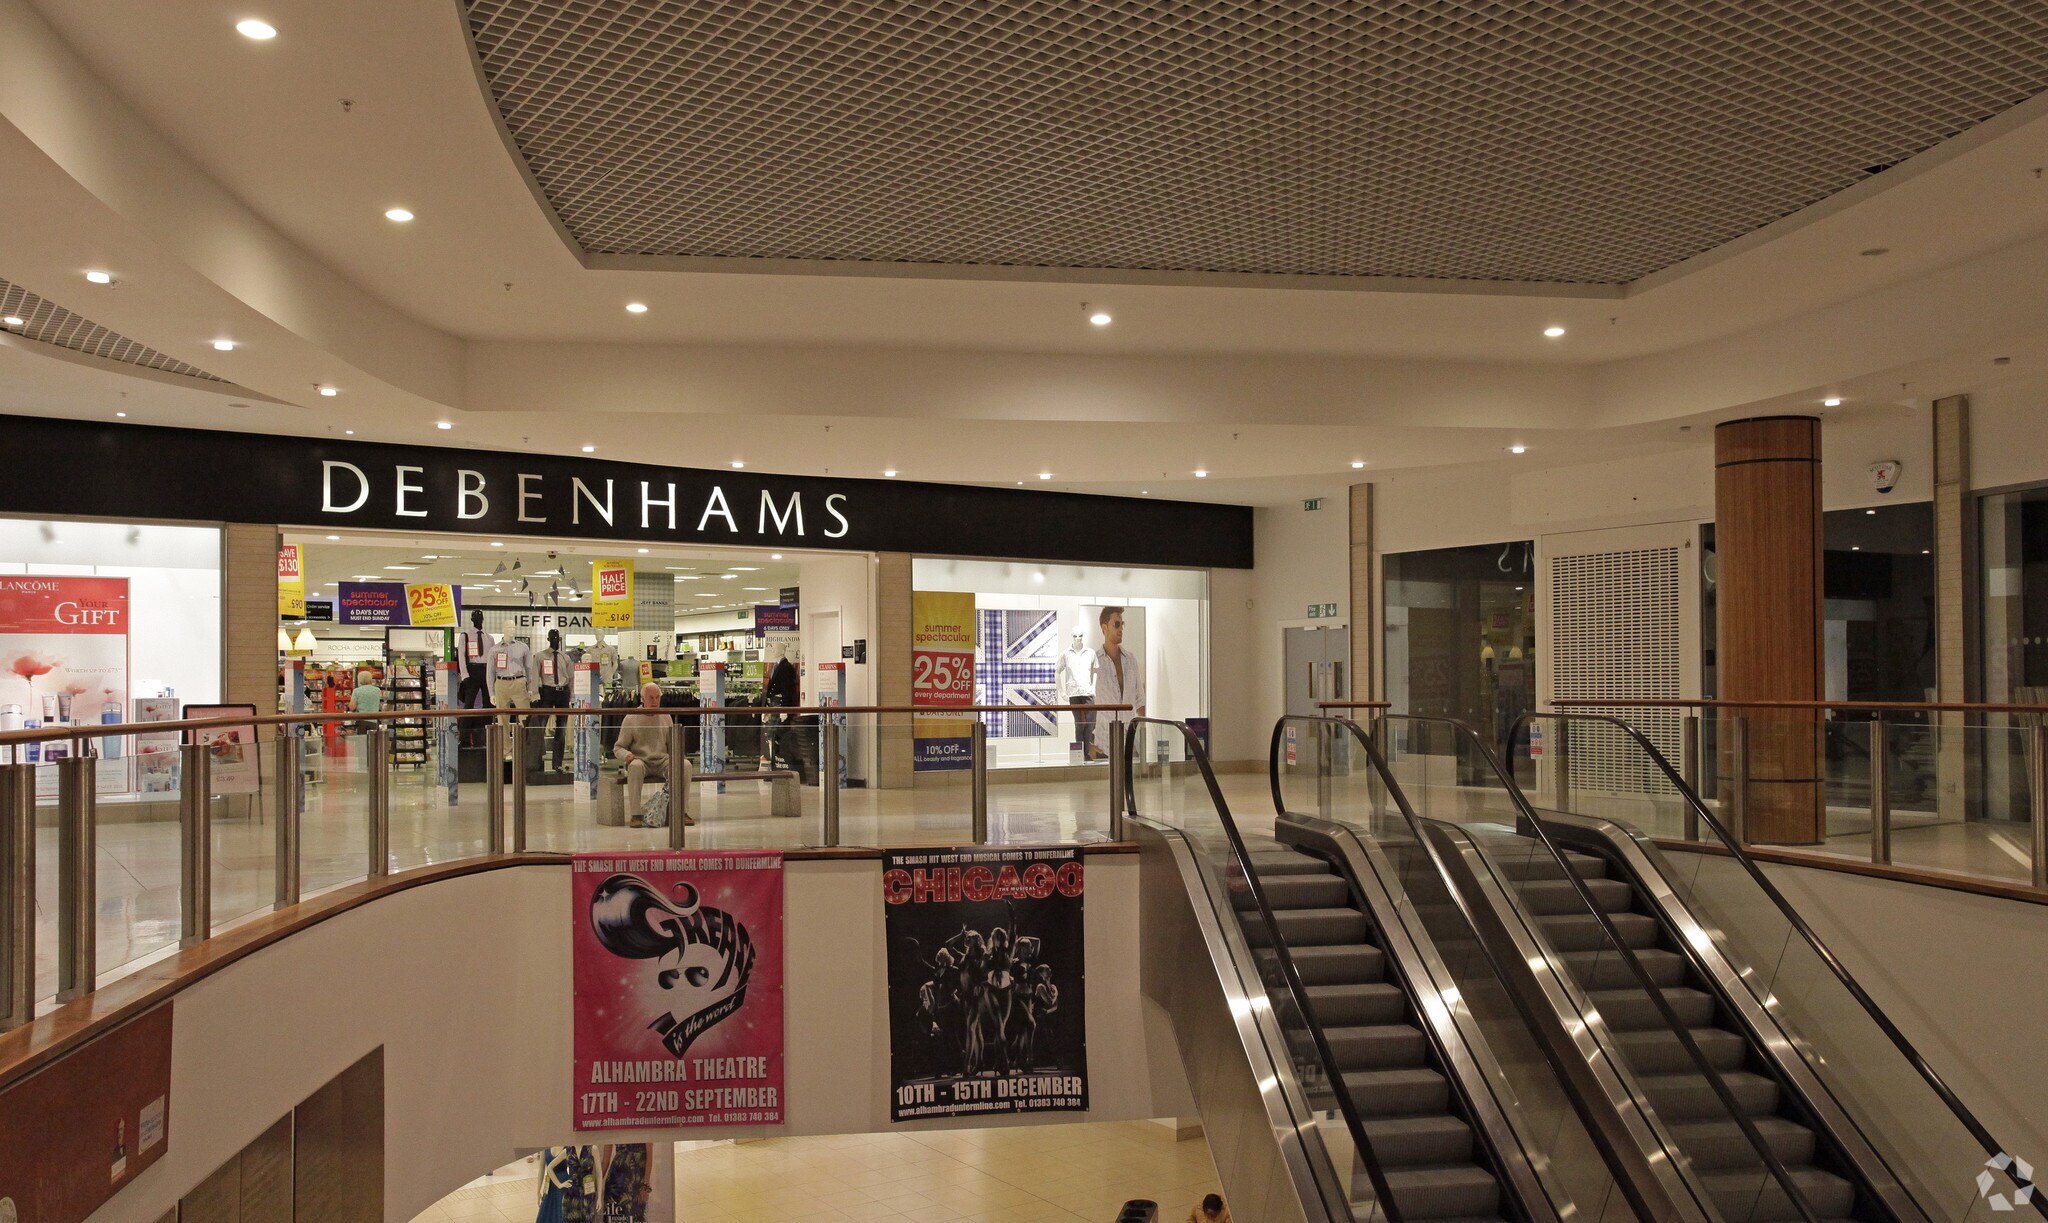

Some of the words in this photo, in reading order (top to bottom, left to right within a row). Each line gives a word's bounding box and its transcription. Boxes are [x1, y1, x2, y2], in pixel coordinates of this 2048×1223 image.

[322, 460, 848, 538] DEBENHAMS
[280, 548, 296, 557] SAVE
[279, 559, 298, 572] £130
[0, 581, 59, 591] LANCÔME
[601, 573, 625, 584] HALF
[601, 583, 625, 593] PRICE
[291, 599, 303, 609] £90
[341, 598, 399, 607] spectacular
[409, 586, 448, 609] 25%
[54, 601, 119, 625] GIFT
[610, 613, 630, 622] £149
[924, 624, 961, 632] summer
[915, 633, 970, 643] spectacular
[913, 655, 971, 690] 25%
[951, 680, 971, 691] OFF
[933, 692, 970, 700] department
[926, 745, 942, 755] 10%
[943, 745, 960, 755] OFF
[573, 860, 587, 873] THE
[588, 859, 614, 872] SMASH
[615, 859, 627, 872] HIT
[629, 859, 649, 872] WEST
[651, 858, 664, 871] END
[666, 858, 697, 871] MUSICAL
[699, 857, 723, 870] COMES
[724, 857, 734, 870] TO
[735, 856, 782, 870] DUNFERMLINE
[892, 856, 904, 865] THE
[905, 856, 927, 864] SMASH
[928, 855, 939, 863] HIT
[941, 854, 959, 863] WEST
[959, 854, 972, 863] END
[973, 853, 1000, 862] MUSICAL
[1001, 852, 1023, 861] COMES
[1024, 852, 1033, 860] TO
[1034, 850, 1074, 860] DUNFERMLINE
[883, 861, 1084, 905] CHICAGO
[612, 895, 756, 992] GREASE
[673, 1031, 684, 1054] is
[684, 1017, 704, 1037] the
[705, 995, 737, 1024] word
[591, 1059, 687, 1084] ALHAMBRA
[693, 1056, 767, 1081] THEATRE
[896, 1084, 935, 1105] 10TH
[952, 1080, 992, 1100] 15TH
[997, 1076, 1082, 1097] DECEMBER
[580, 1092, 618, 1114] 17TH
[635, 1090, 679, 1112] 22ND
[684, 1086, 777, 1111] SEPTEMBER
[898, 1101, 1011, 1117] www.alhambradunfermline.com
[1014, 1100, 1027, 1108] Tel.
[1028, 1099, 1051, 1108] 01383
[1052, 1098, 1066, 1107] 740
[1066, 1098, 1081, 1107] 384
[582, 1114, 704, 1128] www.alhambradunfermline.com
[708, 1113, 722, 1122] Tel.
[724, 1113, 747, 1122] 01383
[749, 1112, 763, 1121] 740
[764, 1112, 779, 1121] 384
